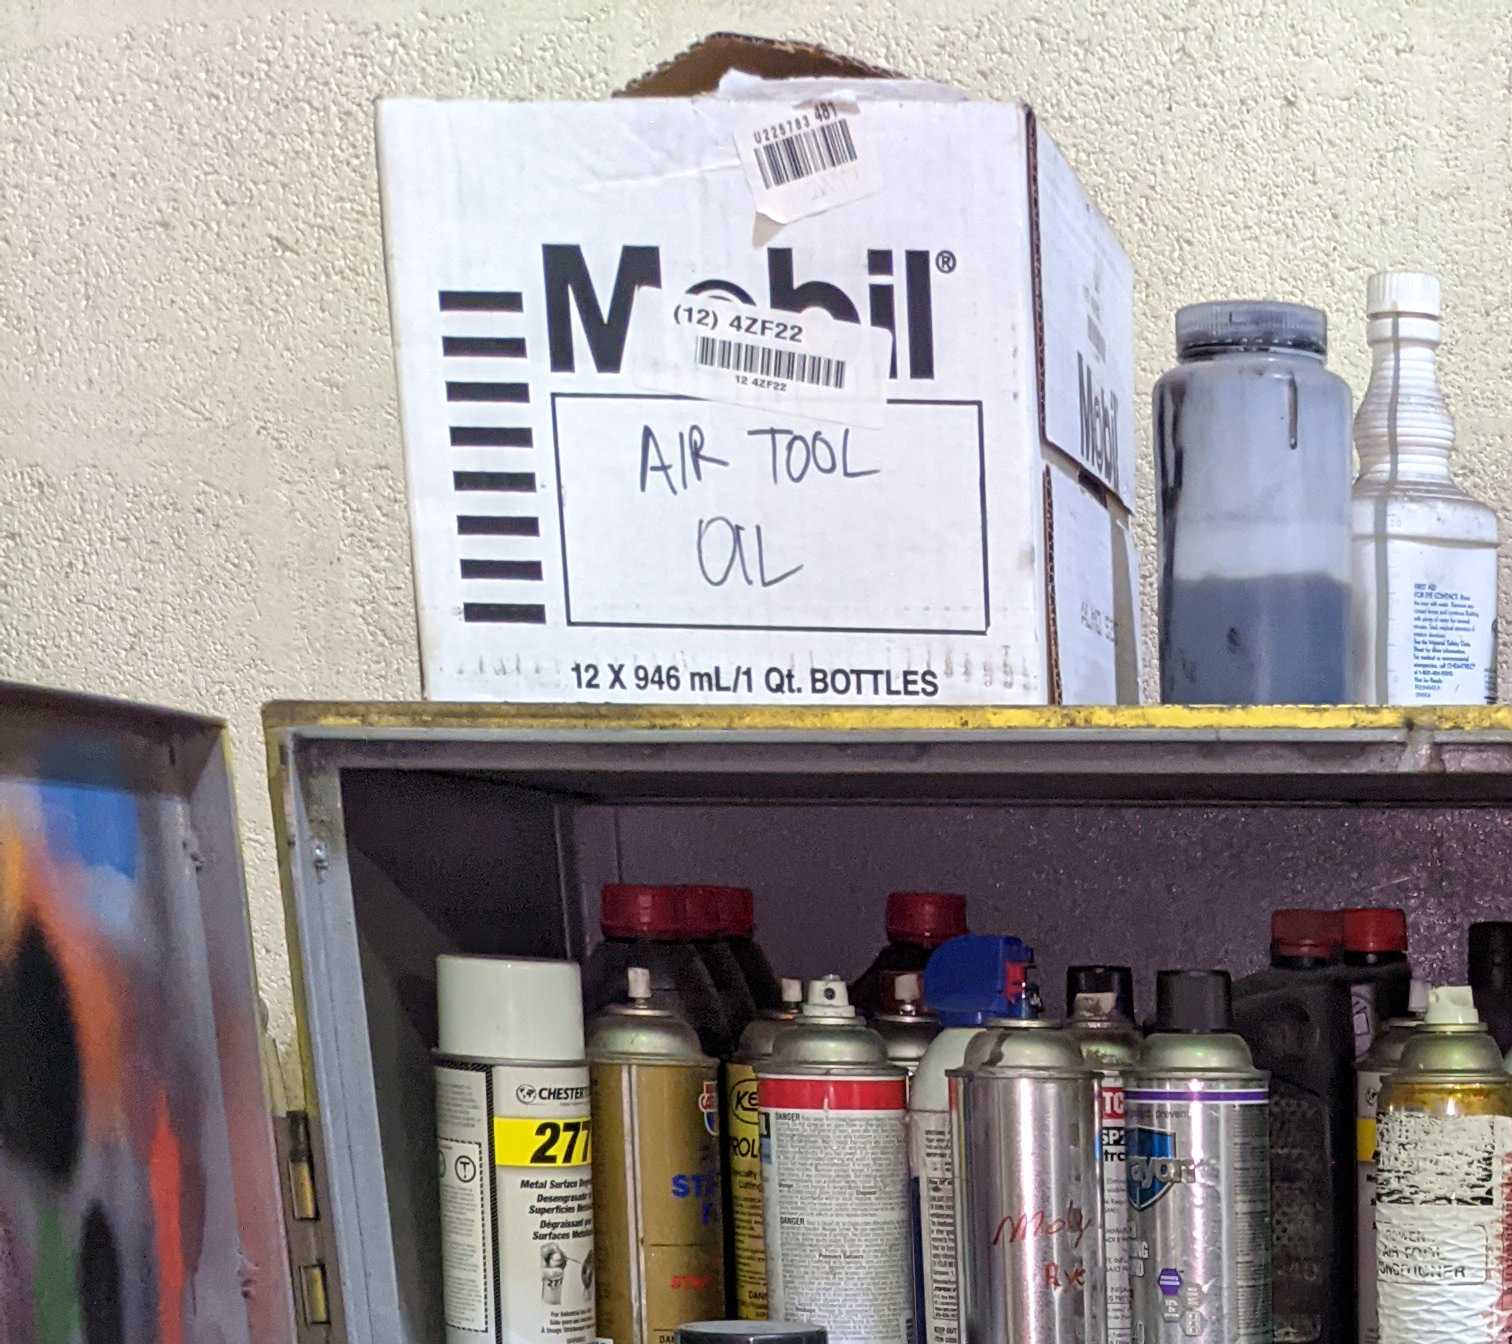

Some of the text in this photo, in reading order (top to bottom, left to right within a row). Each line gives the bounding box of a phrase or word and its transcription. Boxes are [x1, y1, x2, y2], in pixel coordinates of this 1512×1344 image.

[673, 302, 804, 344] (12) 4ZF22
[735, 374, 788, 392] 12 4ZF22
[639, 424, 881, 496] AIR TOOL
[697, 516, 804, 588] OIL
[570, 663, 940, 699] 12 X 946 mL/1 Qt. BOTTLES
[530, 1121, 592, 1164] 277
[520, 1179, 547, 1190] Metal
